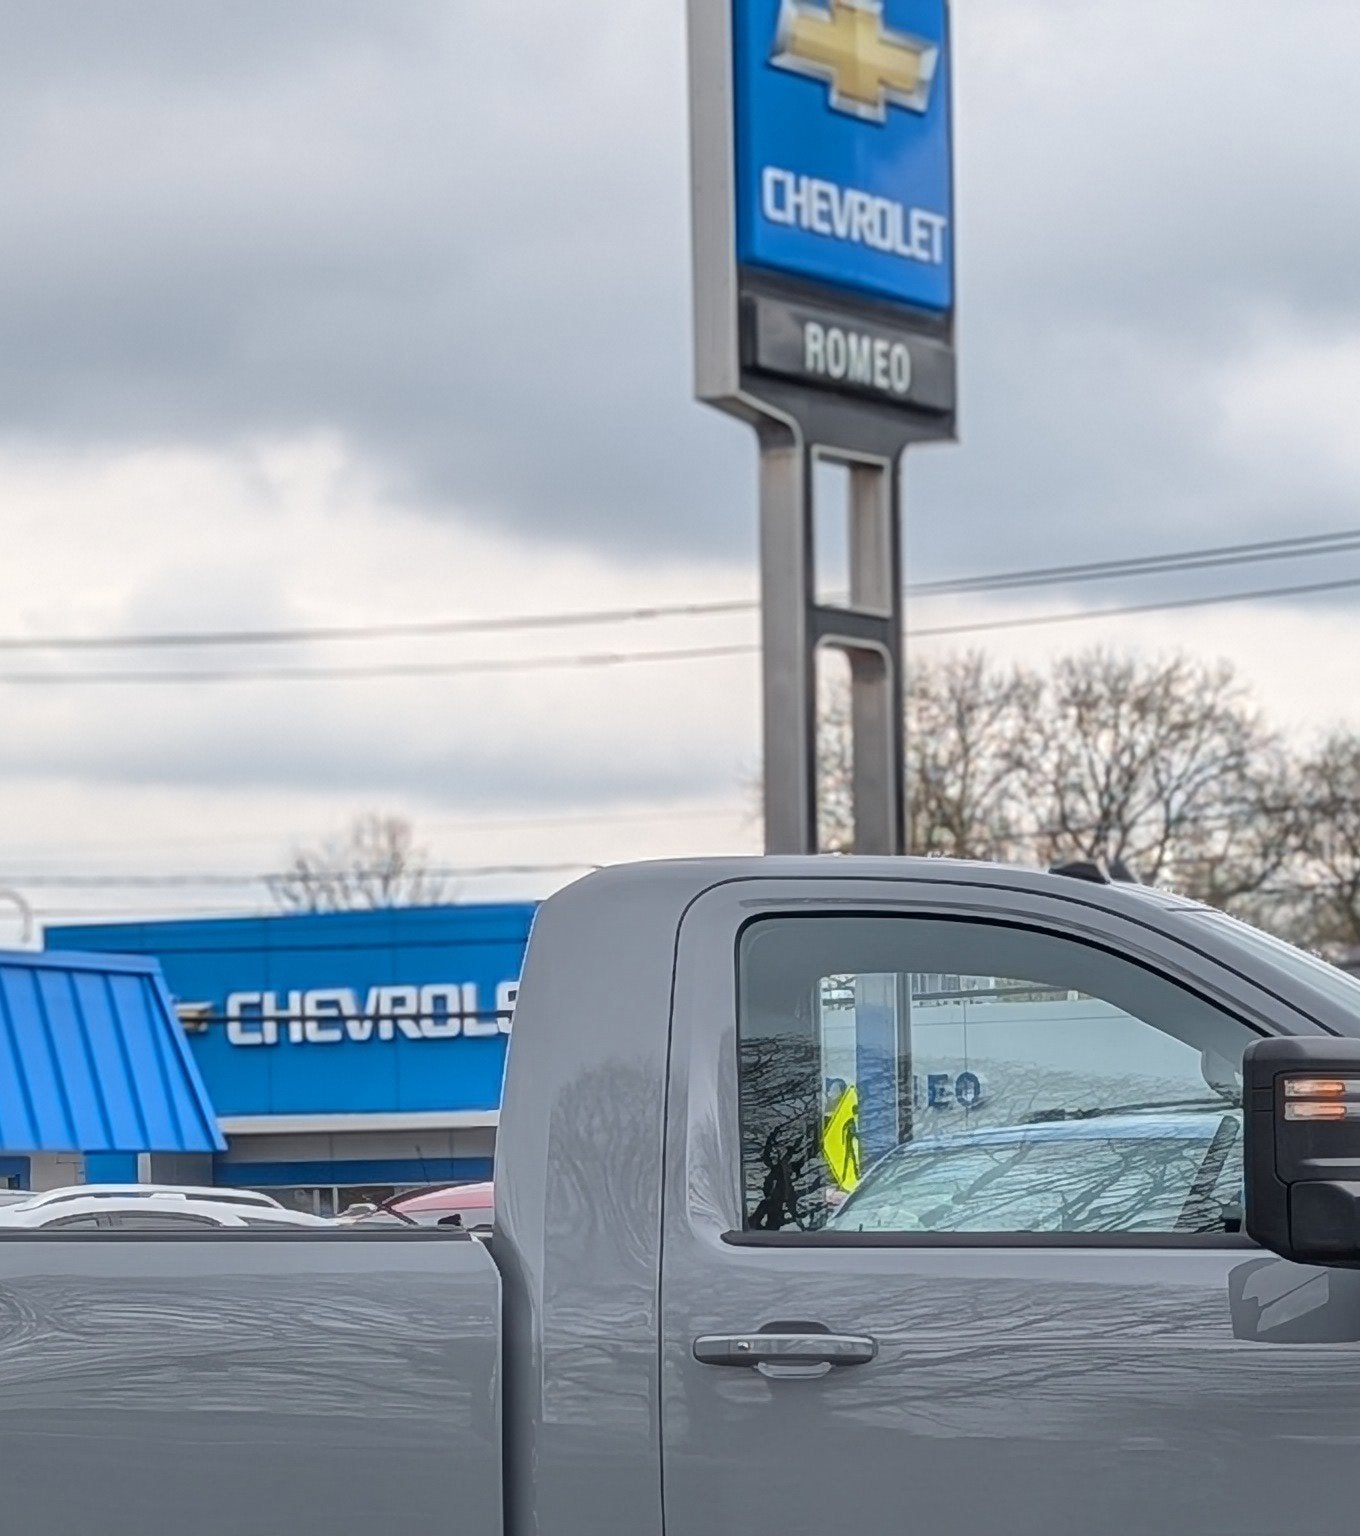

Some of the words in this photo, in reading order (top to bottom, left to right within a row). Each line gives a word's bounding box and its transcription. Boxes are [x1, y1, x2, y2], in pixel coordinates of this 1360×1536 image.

[762, 166, 947, 266] CHEVROLET
[804, 322, 911, 394] ROMEO
[226, 981, 520, 1046] CHEVROL
